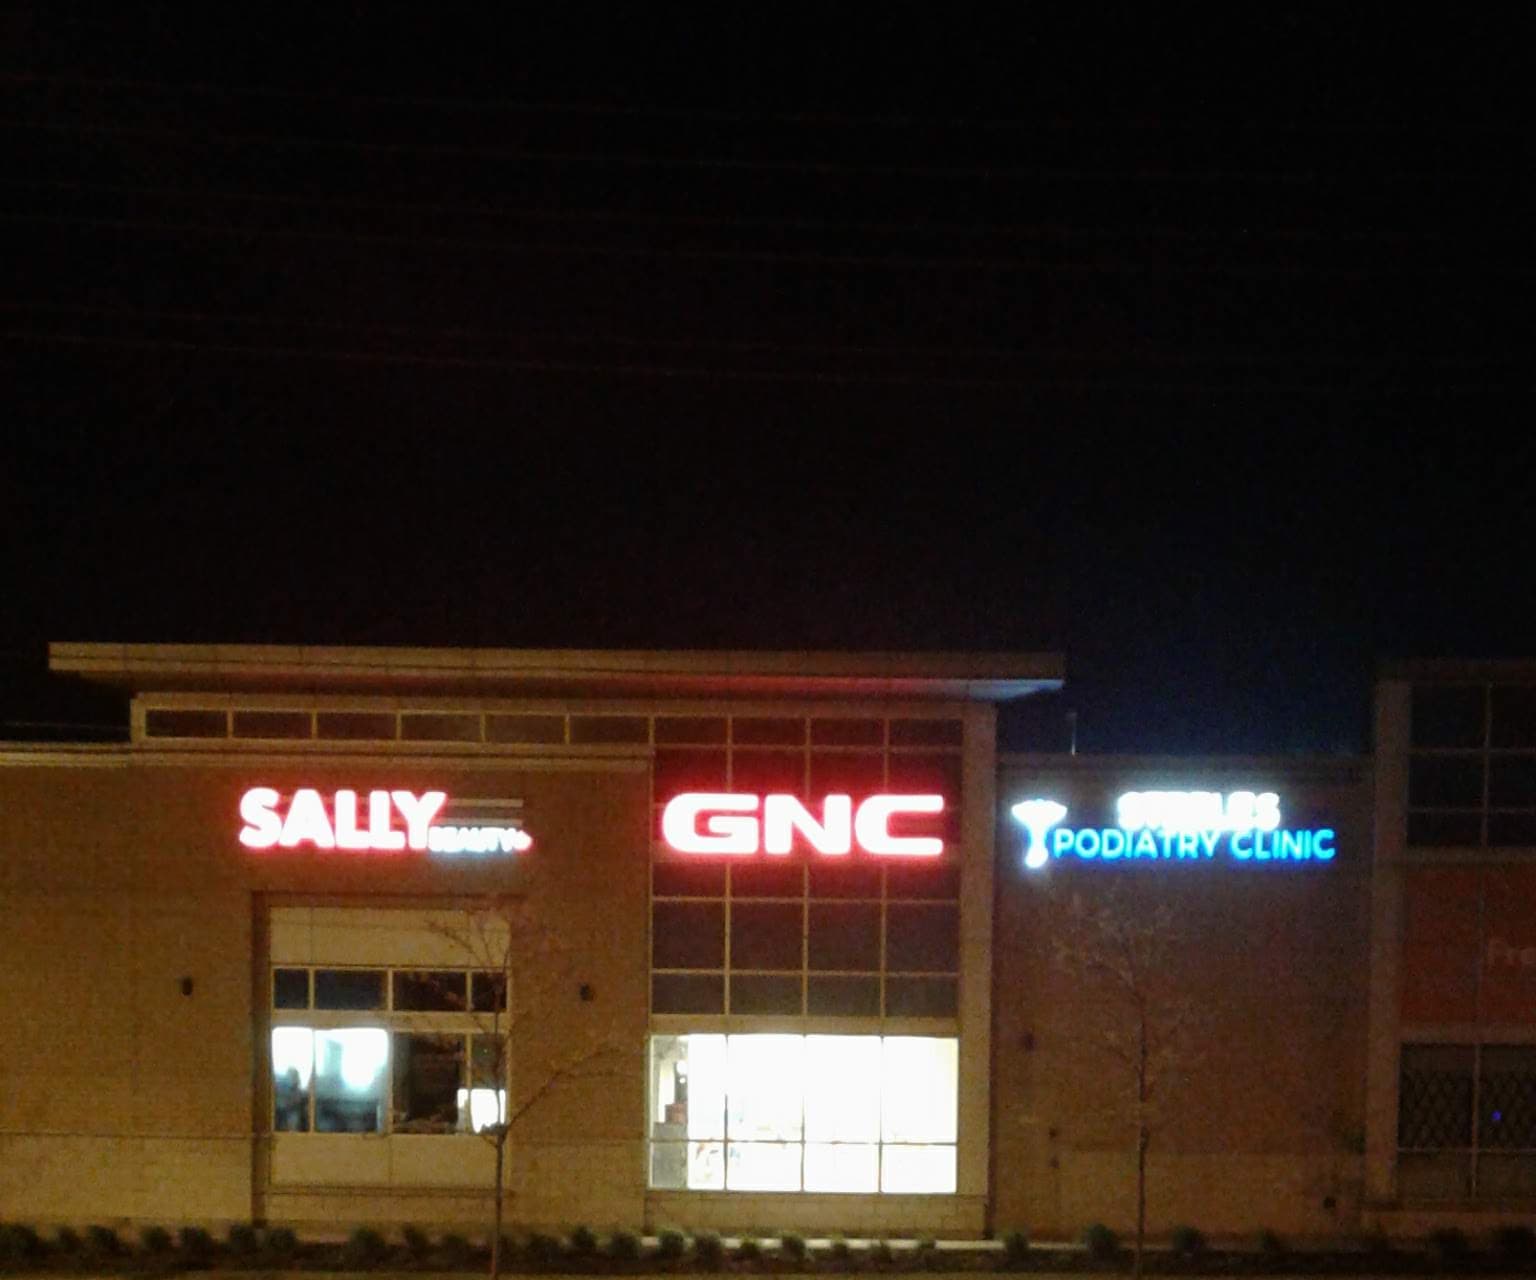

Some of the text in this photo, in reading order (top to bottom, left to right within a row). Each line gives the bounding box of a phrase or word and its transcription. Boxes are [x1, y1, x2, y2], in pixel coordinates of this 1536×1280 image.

[239, 788, 446, 850] SALLY
[662, 793, 944, 855] GNC
[1054, 828, 1336, 860] PODIATRY CLINIC
